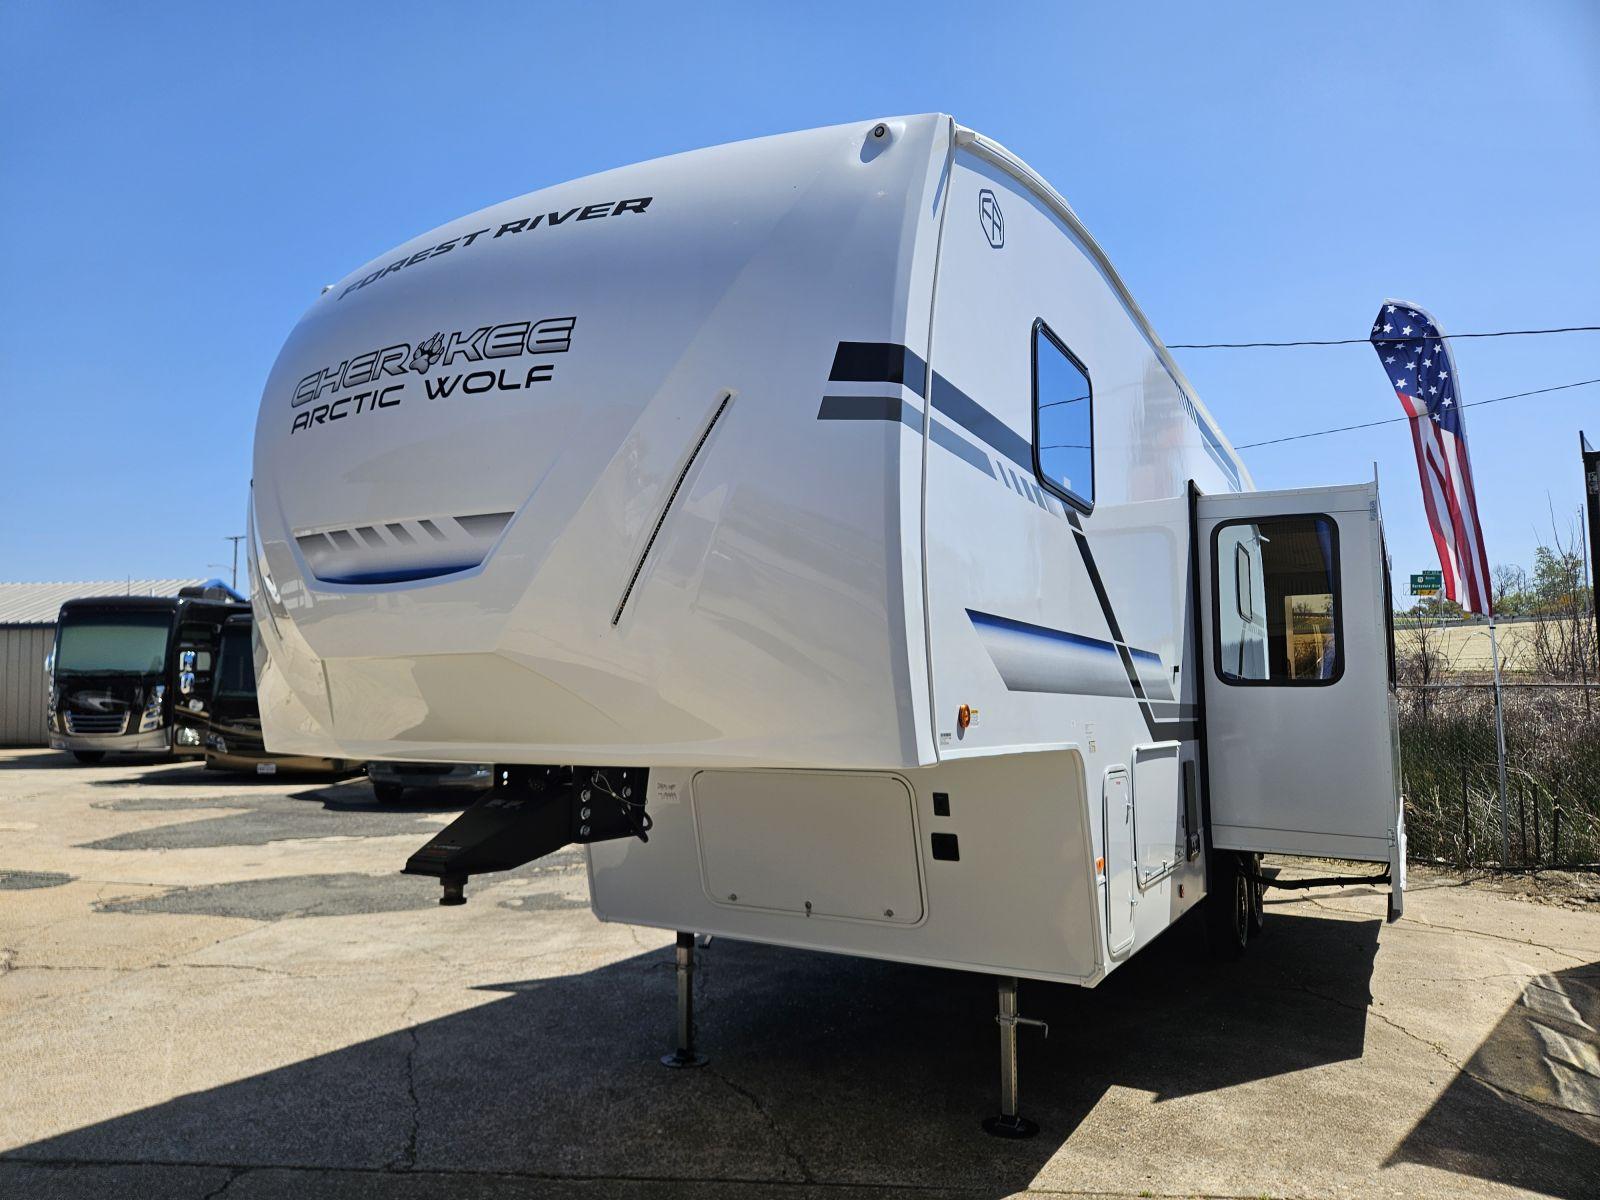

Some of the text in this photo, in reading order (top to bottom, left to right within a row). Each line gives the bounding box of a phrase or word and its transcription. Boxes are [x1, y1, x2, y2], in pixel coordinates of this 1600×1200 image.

[338, 196, 652, 300] FOREST RIVER
[291, 364, 554, 434] ARCTIC WOLF
